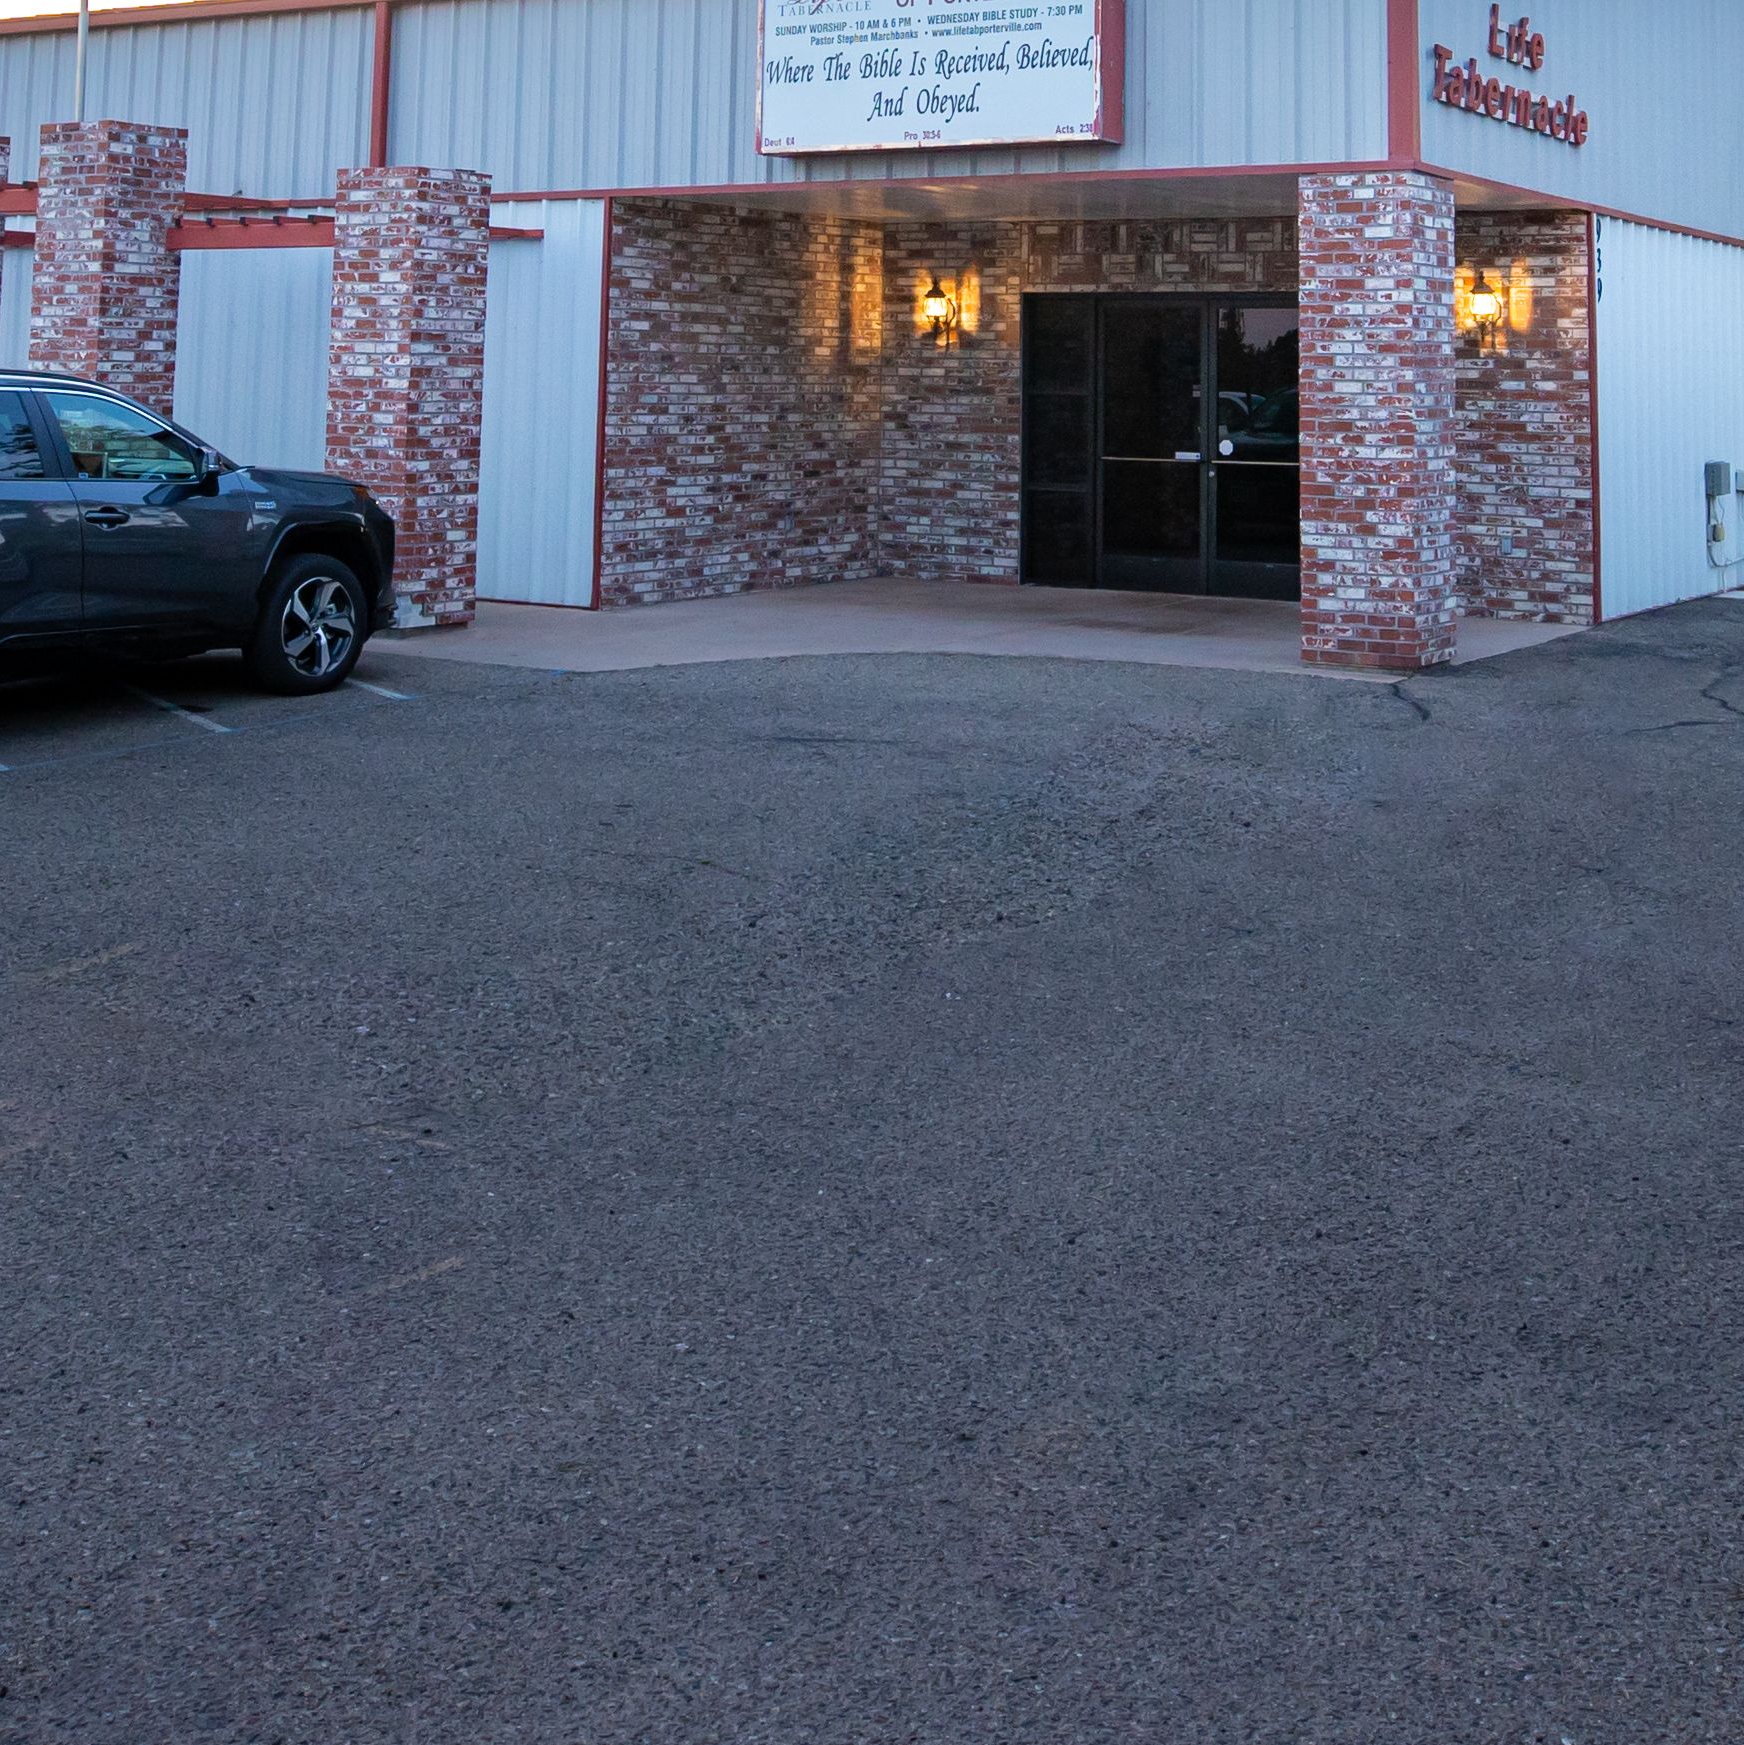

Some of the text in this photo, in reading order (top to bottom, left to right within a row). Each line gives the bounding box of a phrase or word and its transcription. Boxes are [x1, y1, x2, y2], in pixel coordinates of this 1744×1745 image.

[778, 0, 872, 17] TABERNACLE
[927, 12, 980, 25] WEDNESDAY
[982, 9, 1007, 22] BIBLE
[1009, 7, 1039, 20] STUDY
[1047, 5, 1066, 17] 7:30
[1068, 4, 1083, 16] PM
[775, 24, 806, 37] SUNDAY
[809, 21, 848, 33] WORSHIP
[855, 20, 865, 31] 10
[866, 19, 880, 30] AM
[882, 18, 888, 29] &
[891, 18, 896, 28] 6
[899, 17, 912, 27] PM
[1488, 3, 1545, 71] Life
[810, 30, 919, 46] Pastor Stephen Marchbanks
[766, 35, 1094, 85] Where The Bible Is Received, Believed,
[867, 82, 981, 124] And Obeyed.
[1433, 43, 1589, 146] Tabernacle
[1055, 124, 1075, 134] Acts
